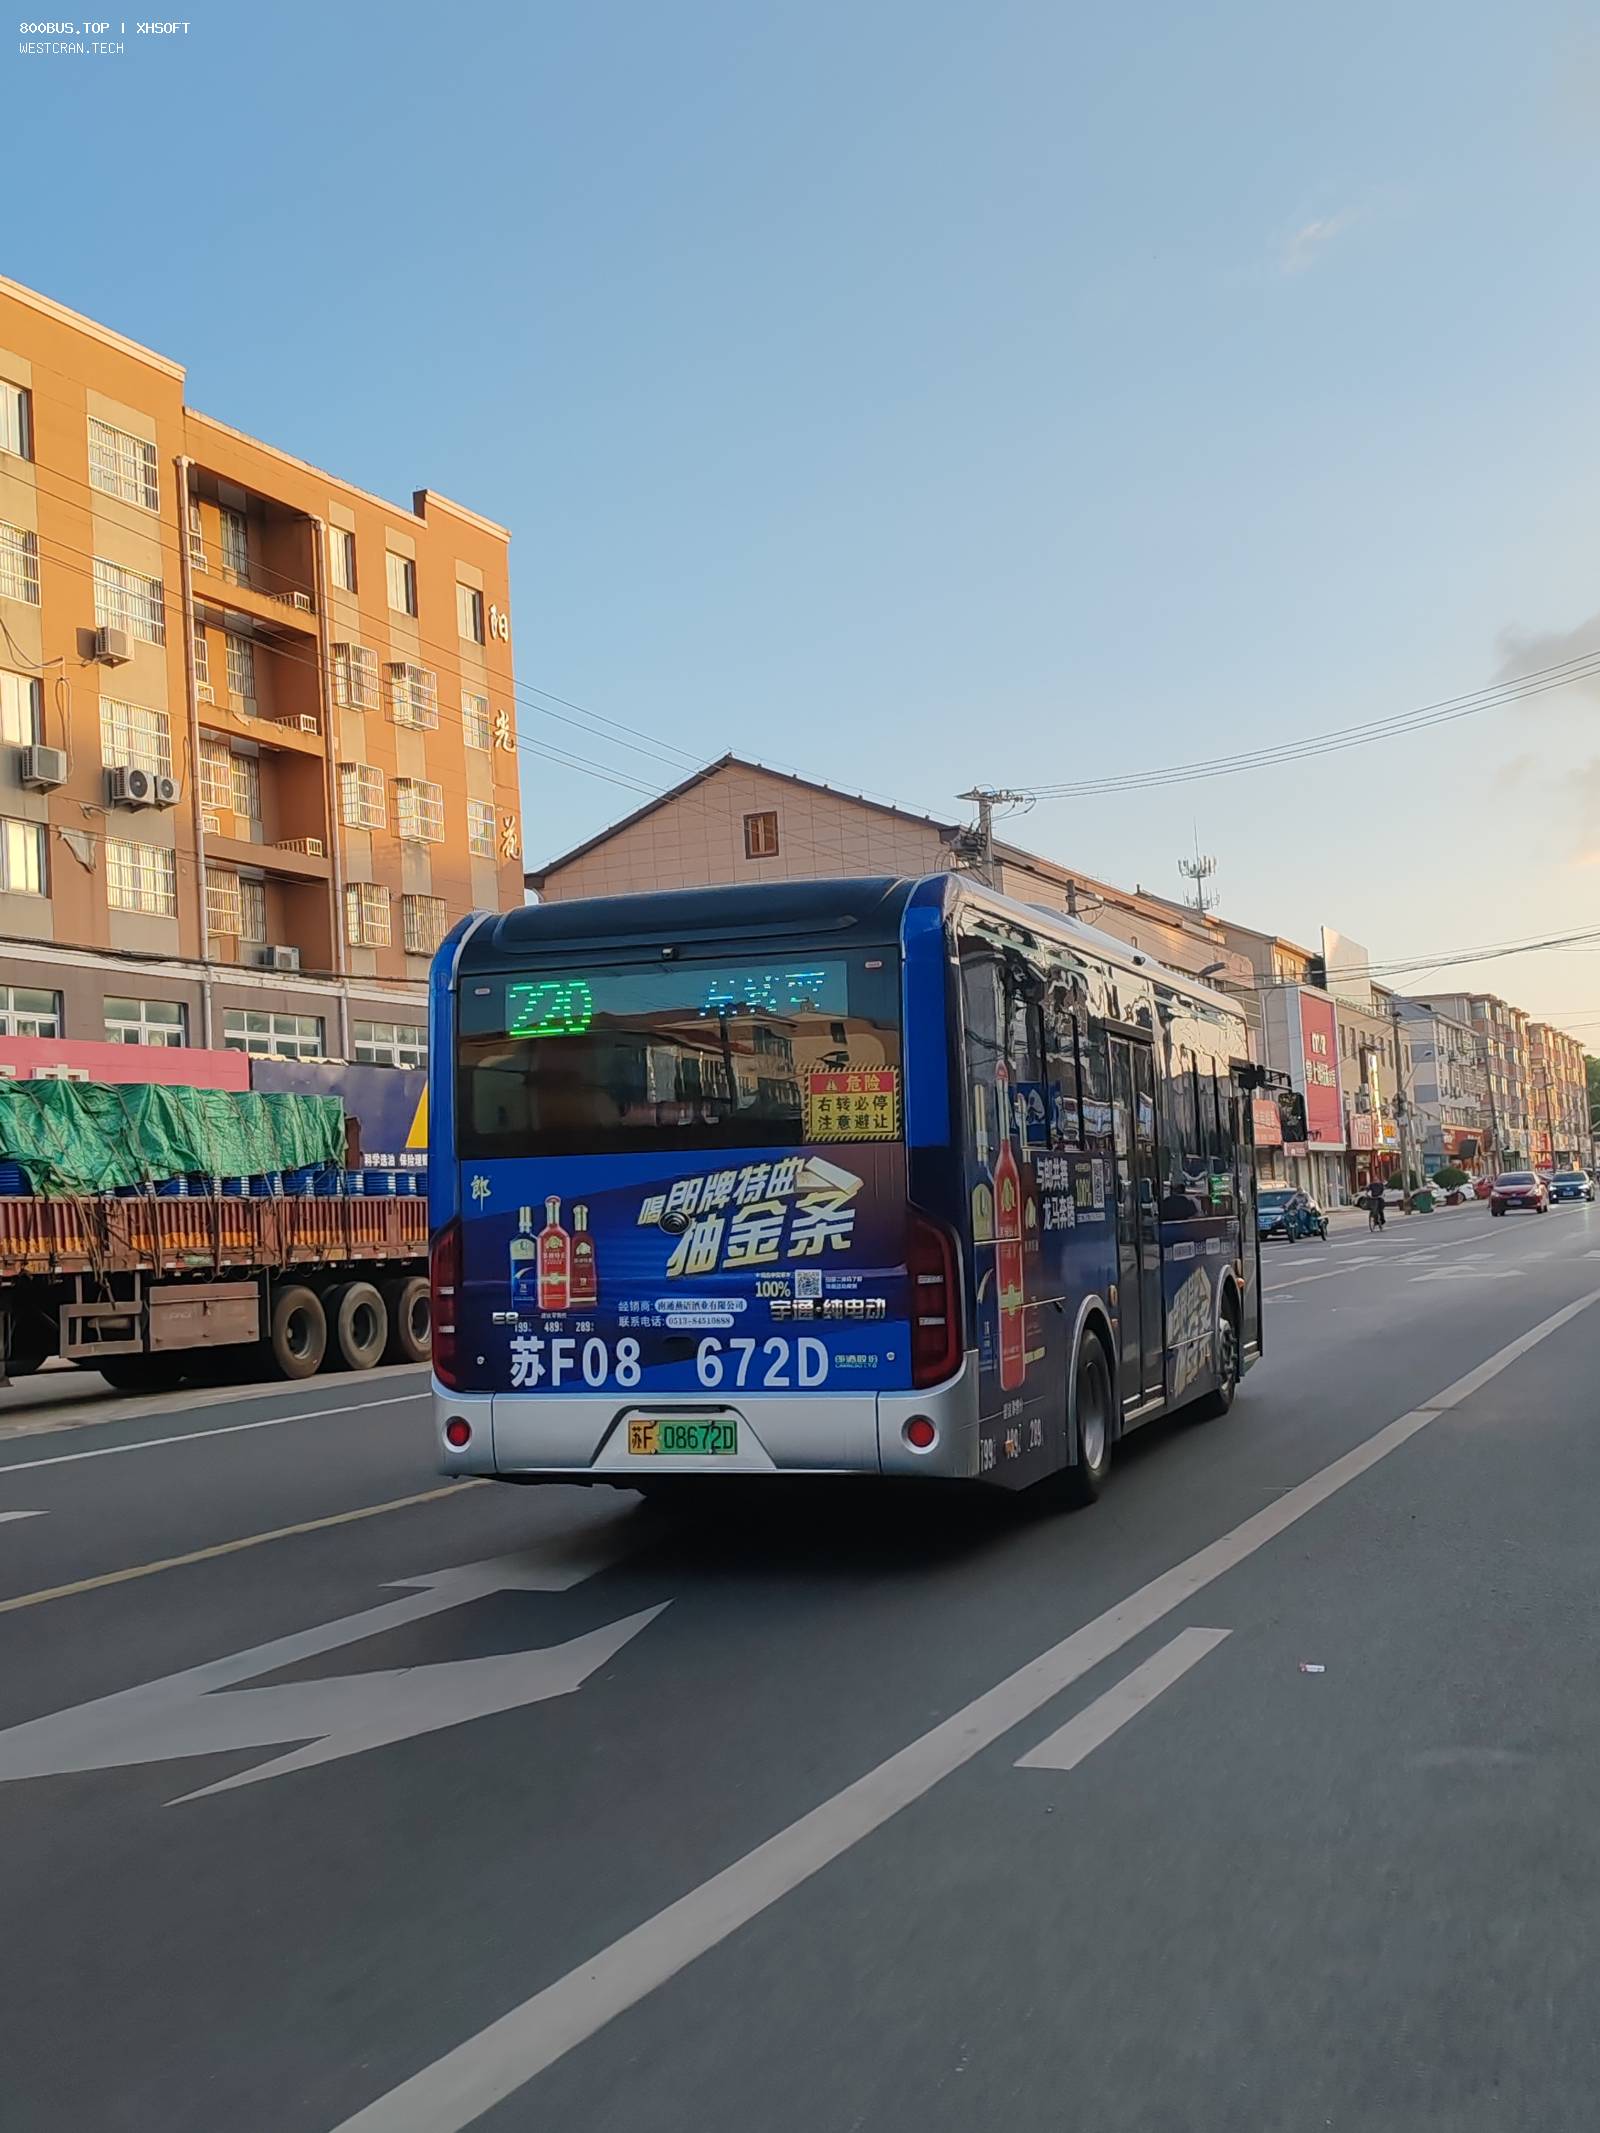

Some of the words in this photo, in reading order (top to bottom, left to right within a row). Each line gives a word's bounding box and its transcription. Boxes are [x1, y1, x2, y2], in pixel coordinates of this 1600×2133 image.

[846, 1074, 881, 1092] 危险
[818, 1095, 888, 1112] 右转必停
[818, 1114, 888, 1131] 注意避让
[665, 1190, 858, 1277] 抽金条
[755, 1280, 791, 1298] 100%
[492, 1311, 519, 1325] E8
[509, 1336, 642, 1388] 苏F08
[697, 1337, 829, 1388] 672D
